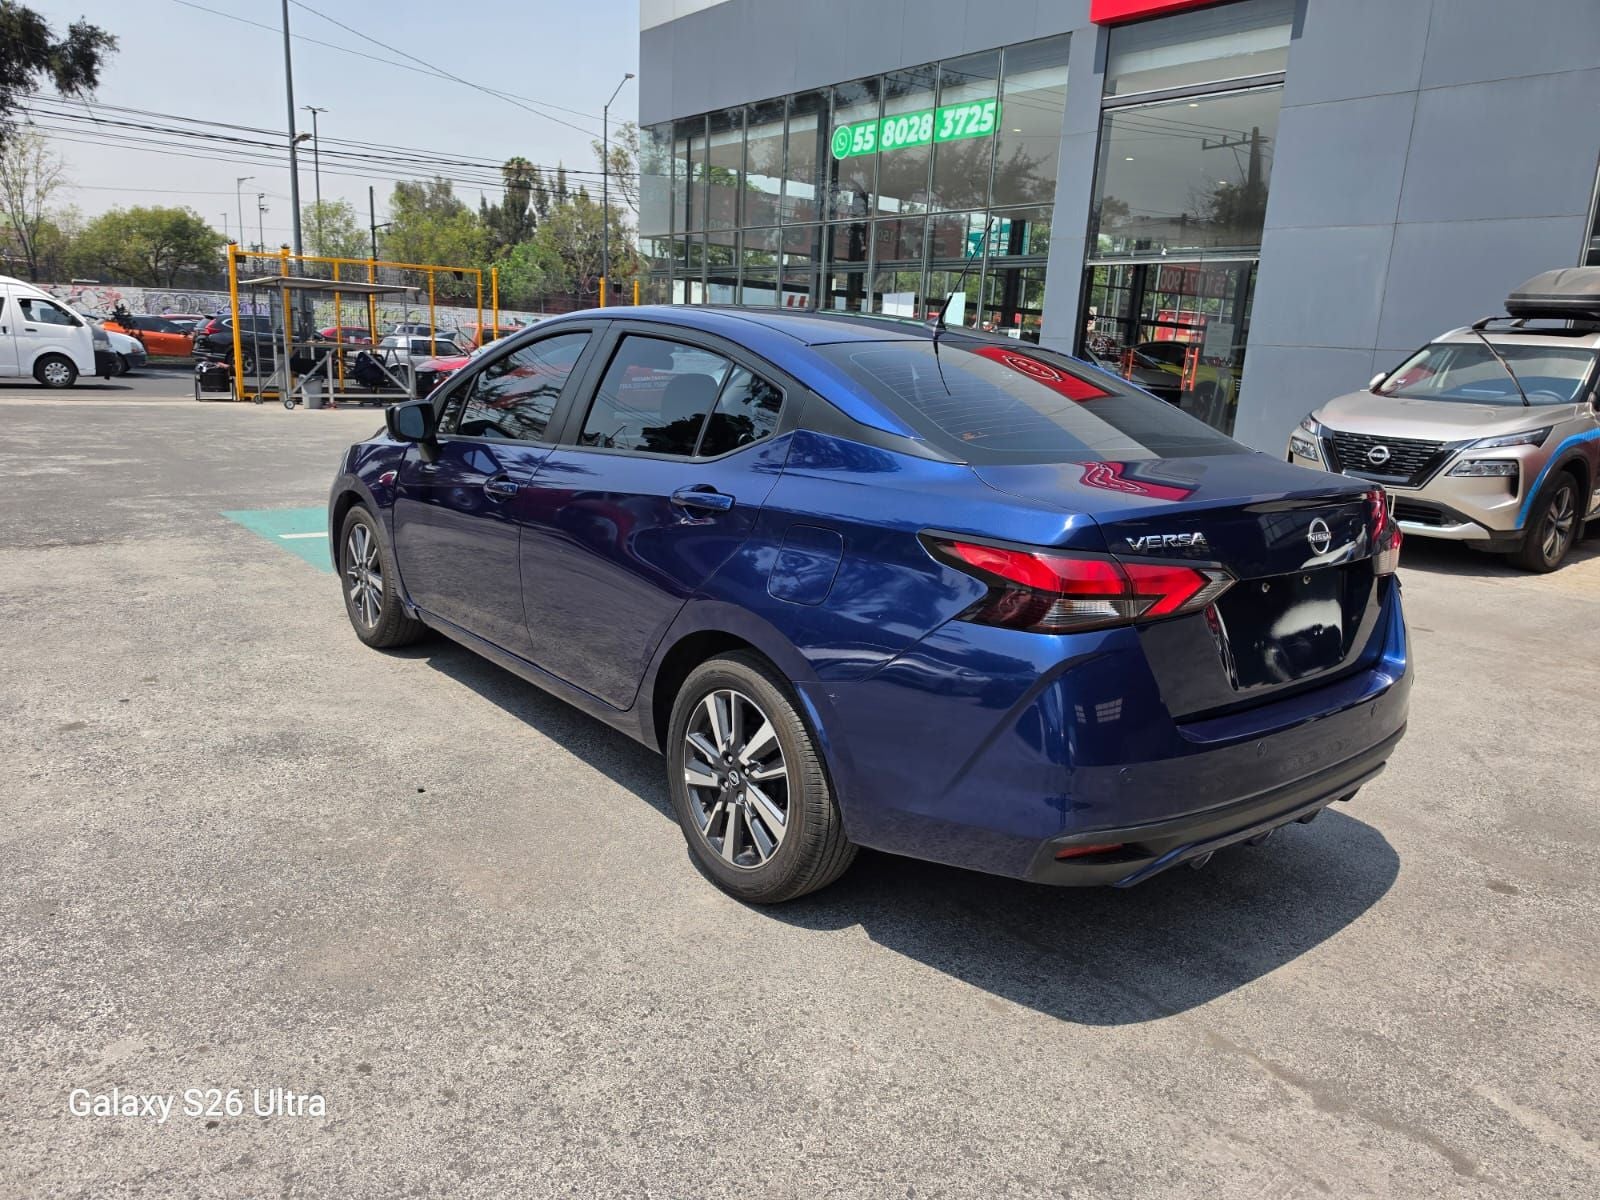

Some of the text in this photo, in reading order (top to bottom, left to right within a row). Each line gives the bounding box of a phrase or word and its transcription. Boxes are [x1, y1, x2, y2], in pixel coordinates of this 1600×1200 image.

[852, 102, 997, 152] 55 8028 3725
[1125, 532, 1207, 551] VERSA
